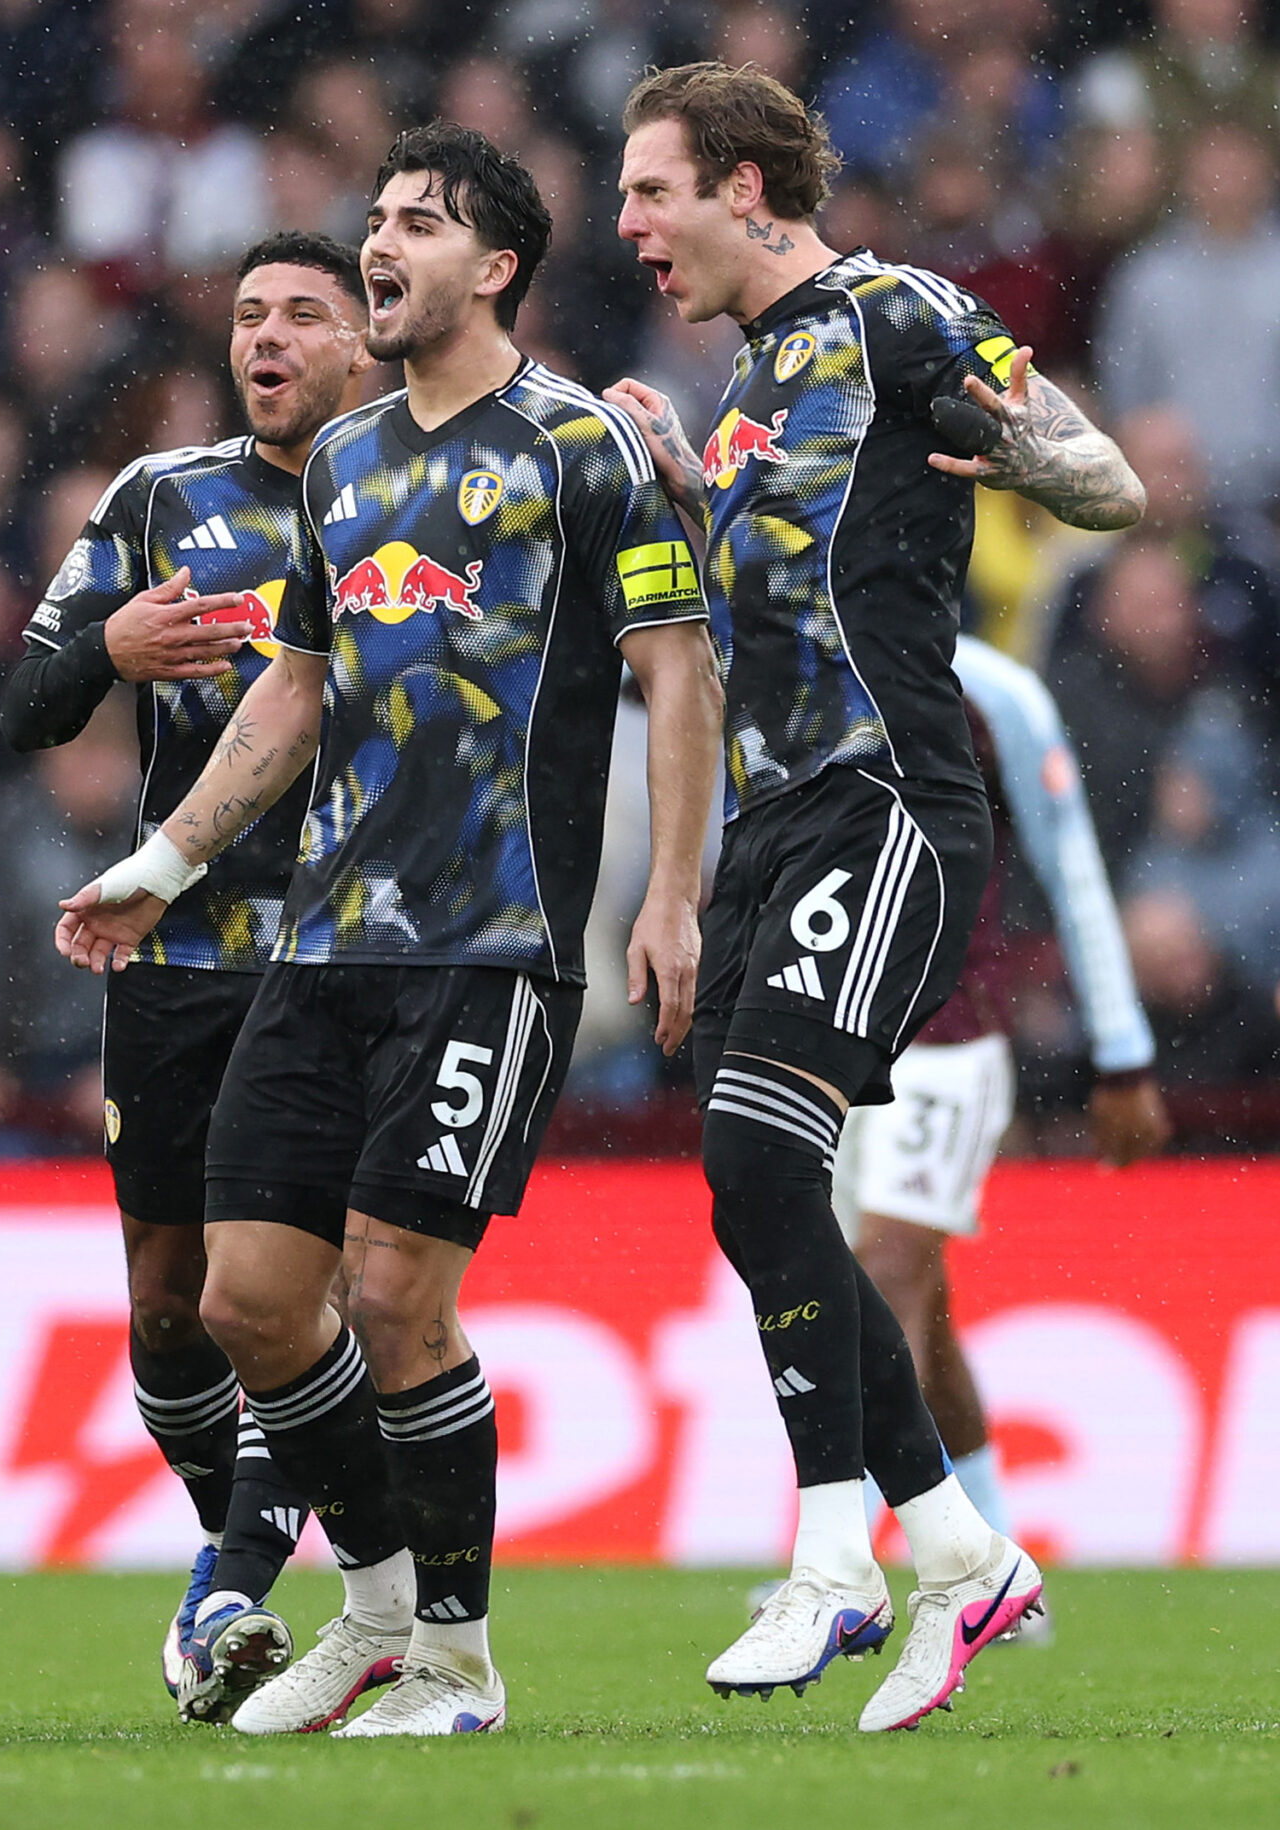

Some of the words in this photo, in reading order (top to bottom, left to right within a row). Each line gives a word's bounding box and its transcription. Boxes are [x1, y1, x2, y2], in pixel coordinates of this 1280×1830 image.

[628, 587, 699, 606] PARIMATCH
[790, 867, 853, 953] 6
[430, 1039, 494, 1129] 5
[896, 1089, 964, 1165] 31
